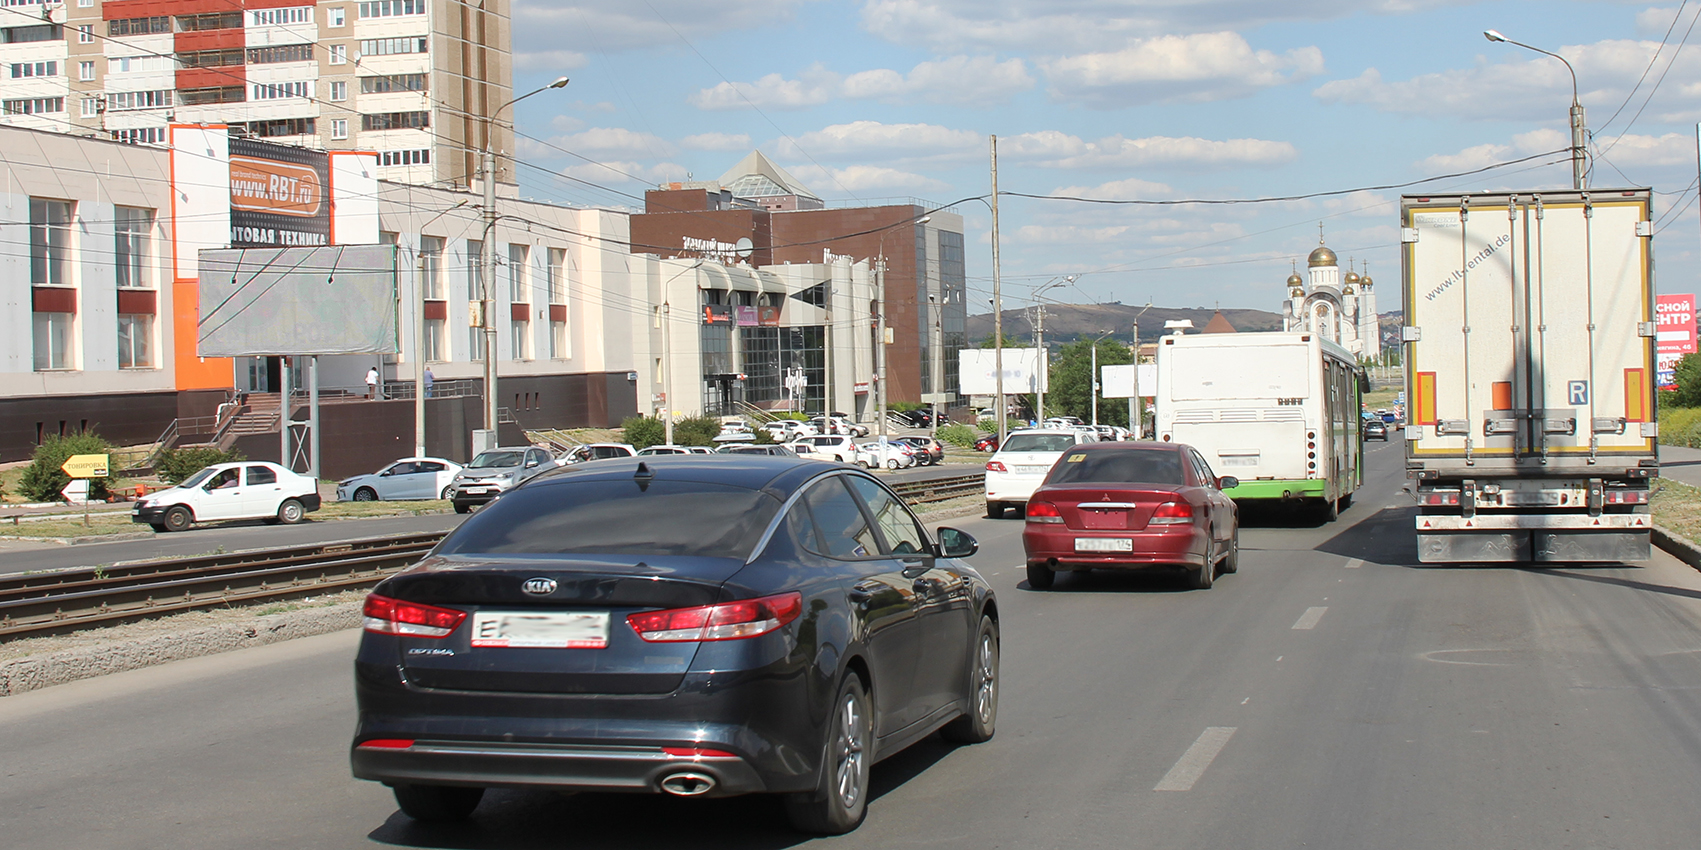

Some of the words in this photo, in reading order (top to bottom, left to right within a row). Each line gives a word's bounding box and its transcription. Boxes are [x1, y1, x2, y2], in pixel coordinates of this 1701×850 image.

[231, 173, 311, 204] www.RBT.ru
[279, 230, 327, 246] ТЕХНИКА
[1570, 382, 1586, 403] R
[527, 580, 551, 592] KIA
